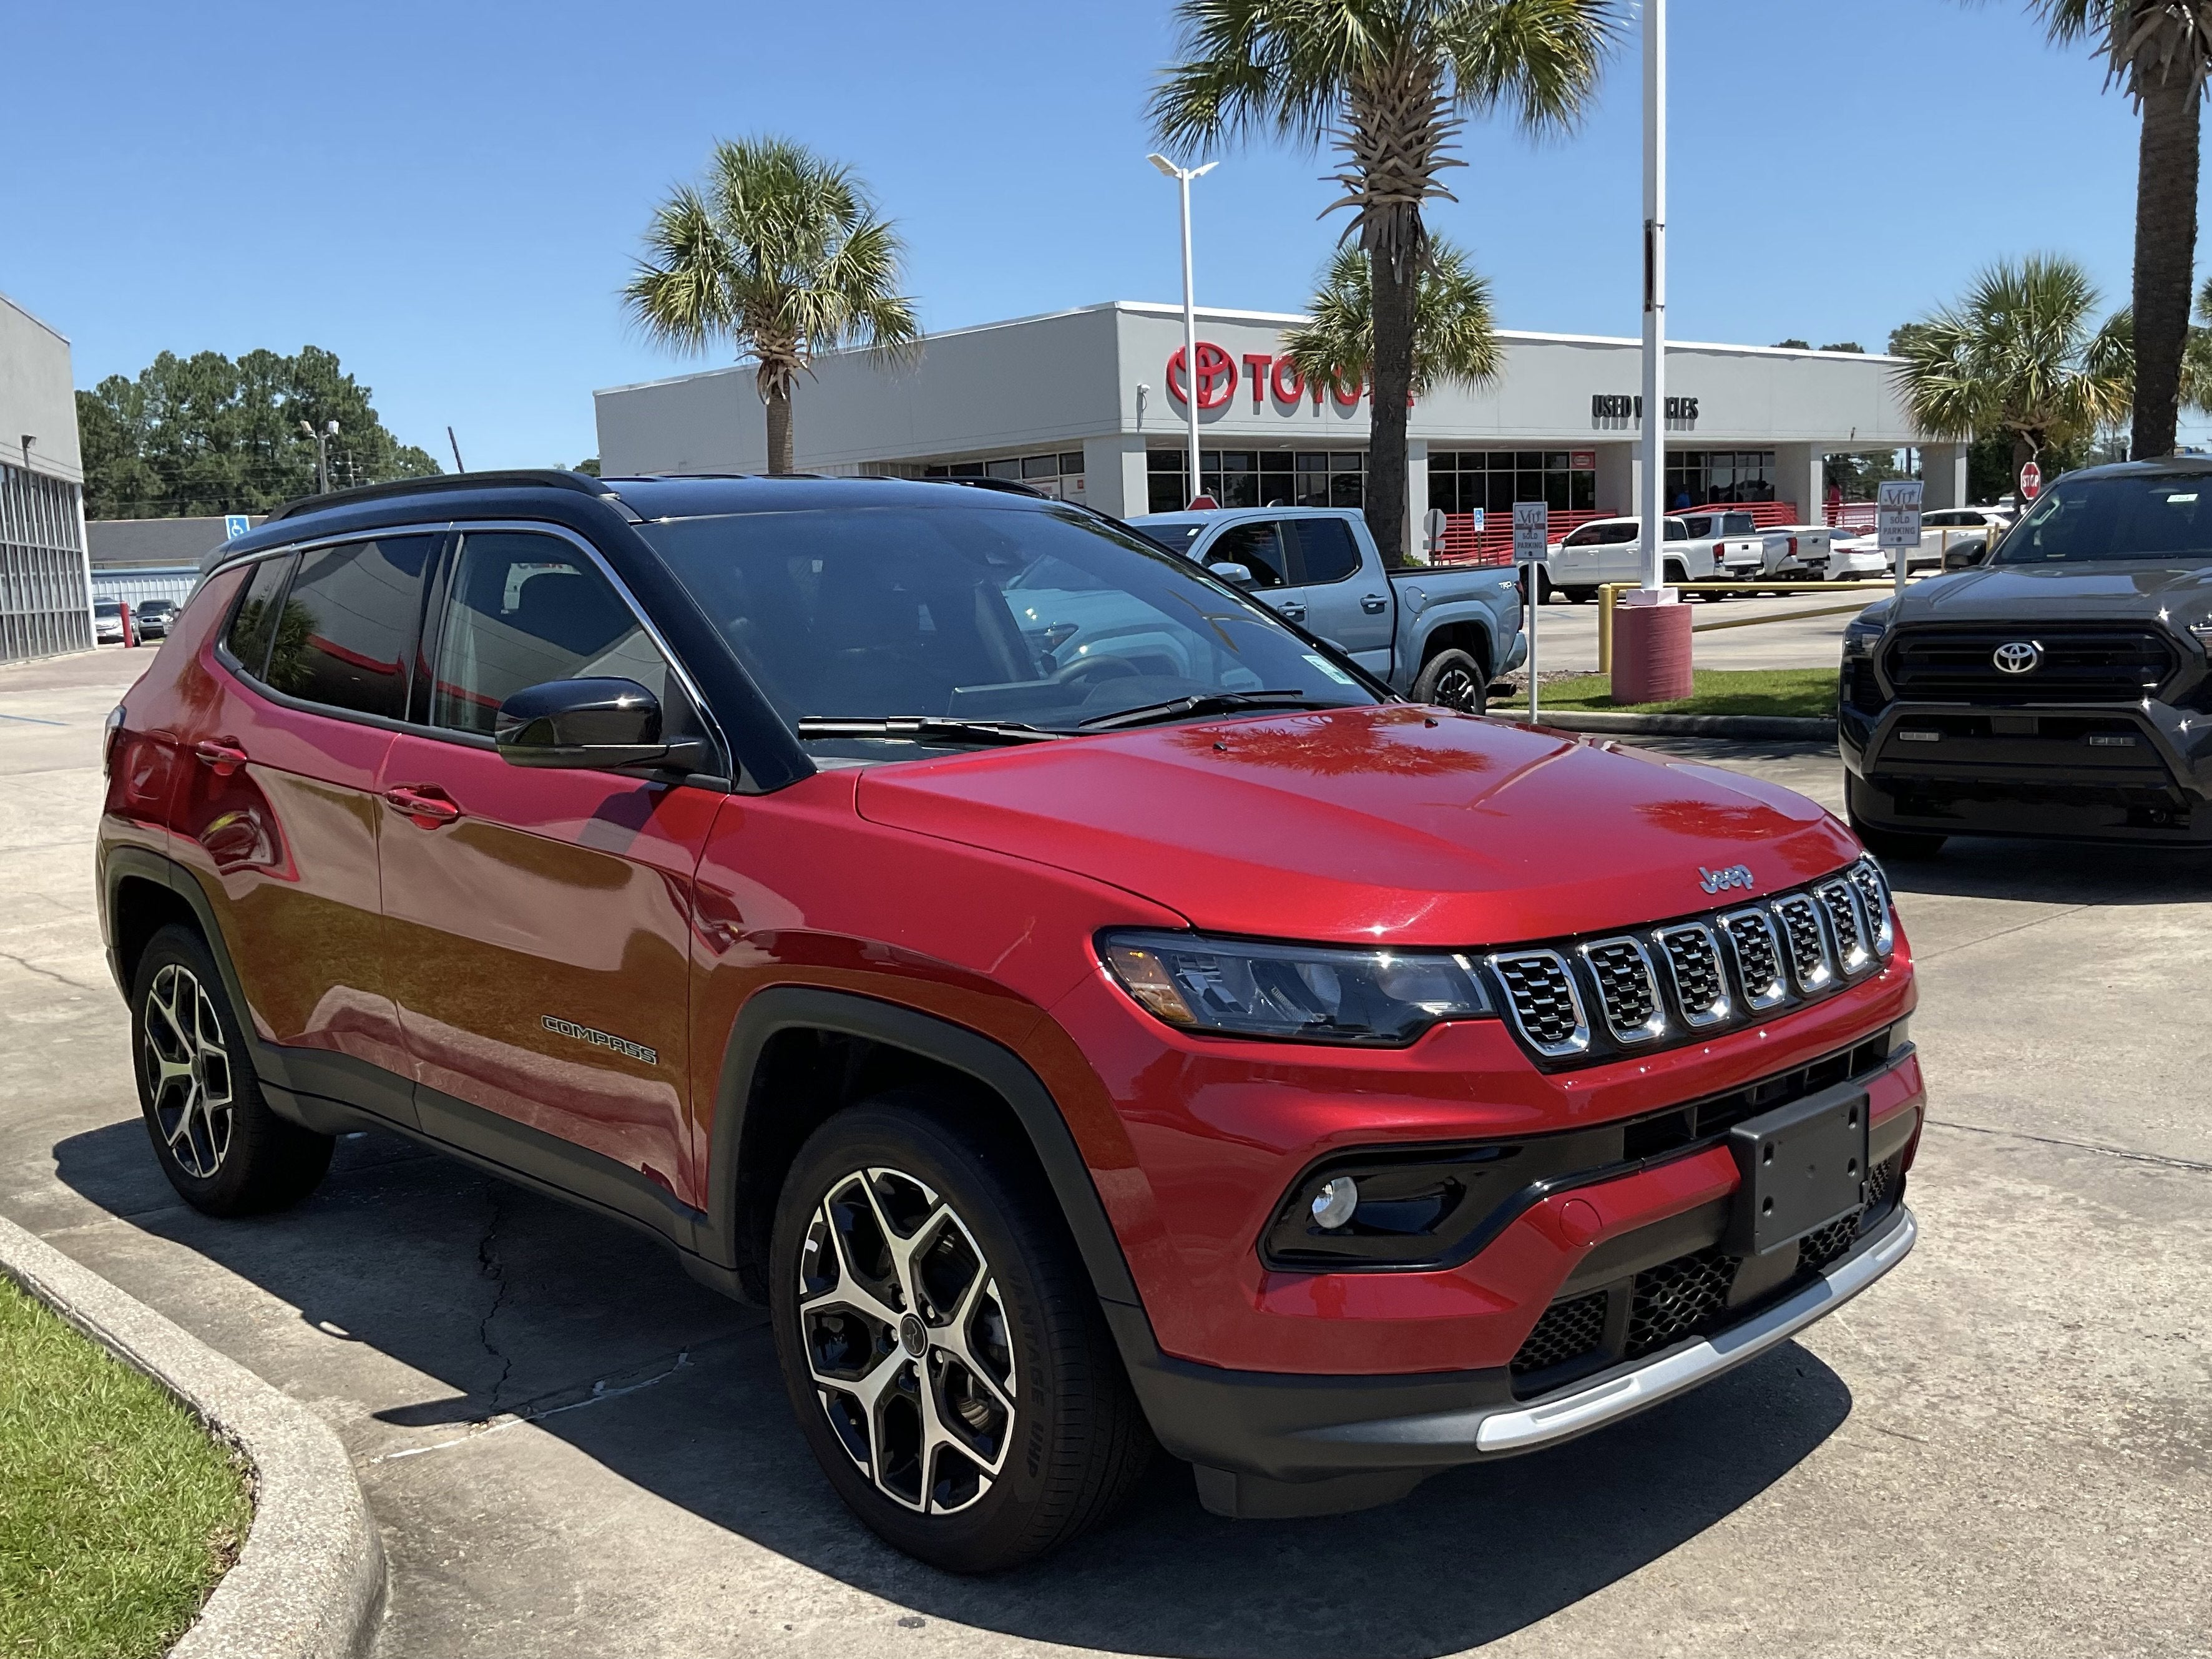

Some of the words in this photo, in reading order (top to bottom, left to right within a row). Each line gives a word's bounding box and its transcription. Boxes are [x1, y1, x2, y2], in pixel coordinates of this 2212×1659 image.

[1592, 394, 1632, 418] USED
[1633, 396, 1698, 419] VCLES
[2022, 474, 2039, 487] STOP
[1883, 527, 1916, 535] PARKING
[1890, 516, 1909, 524] SOLD
[1698, 864, 1753, 894] Jeep
[541, 1015, 657, 1065] COMPASS
[1026, 1420, 1045, 1478] UHP
